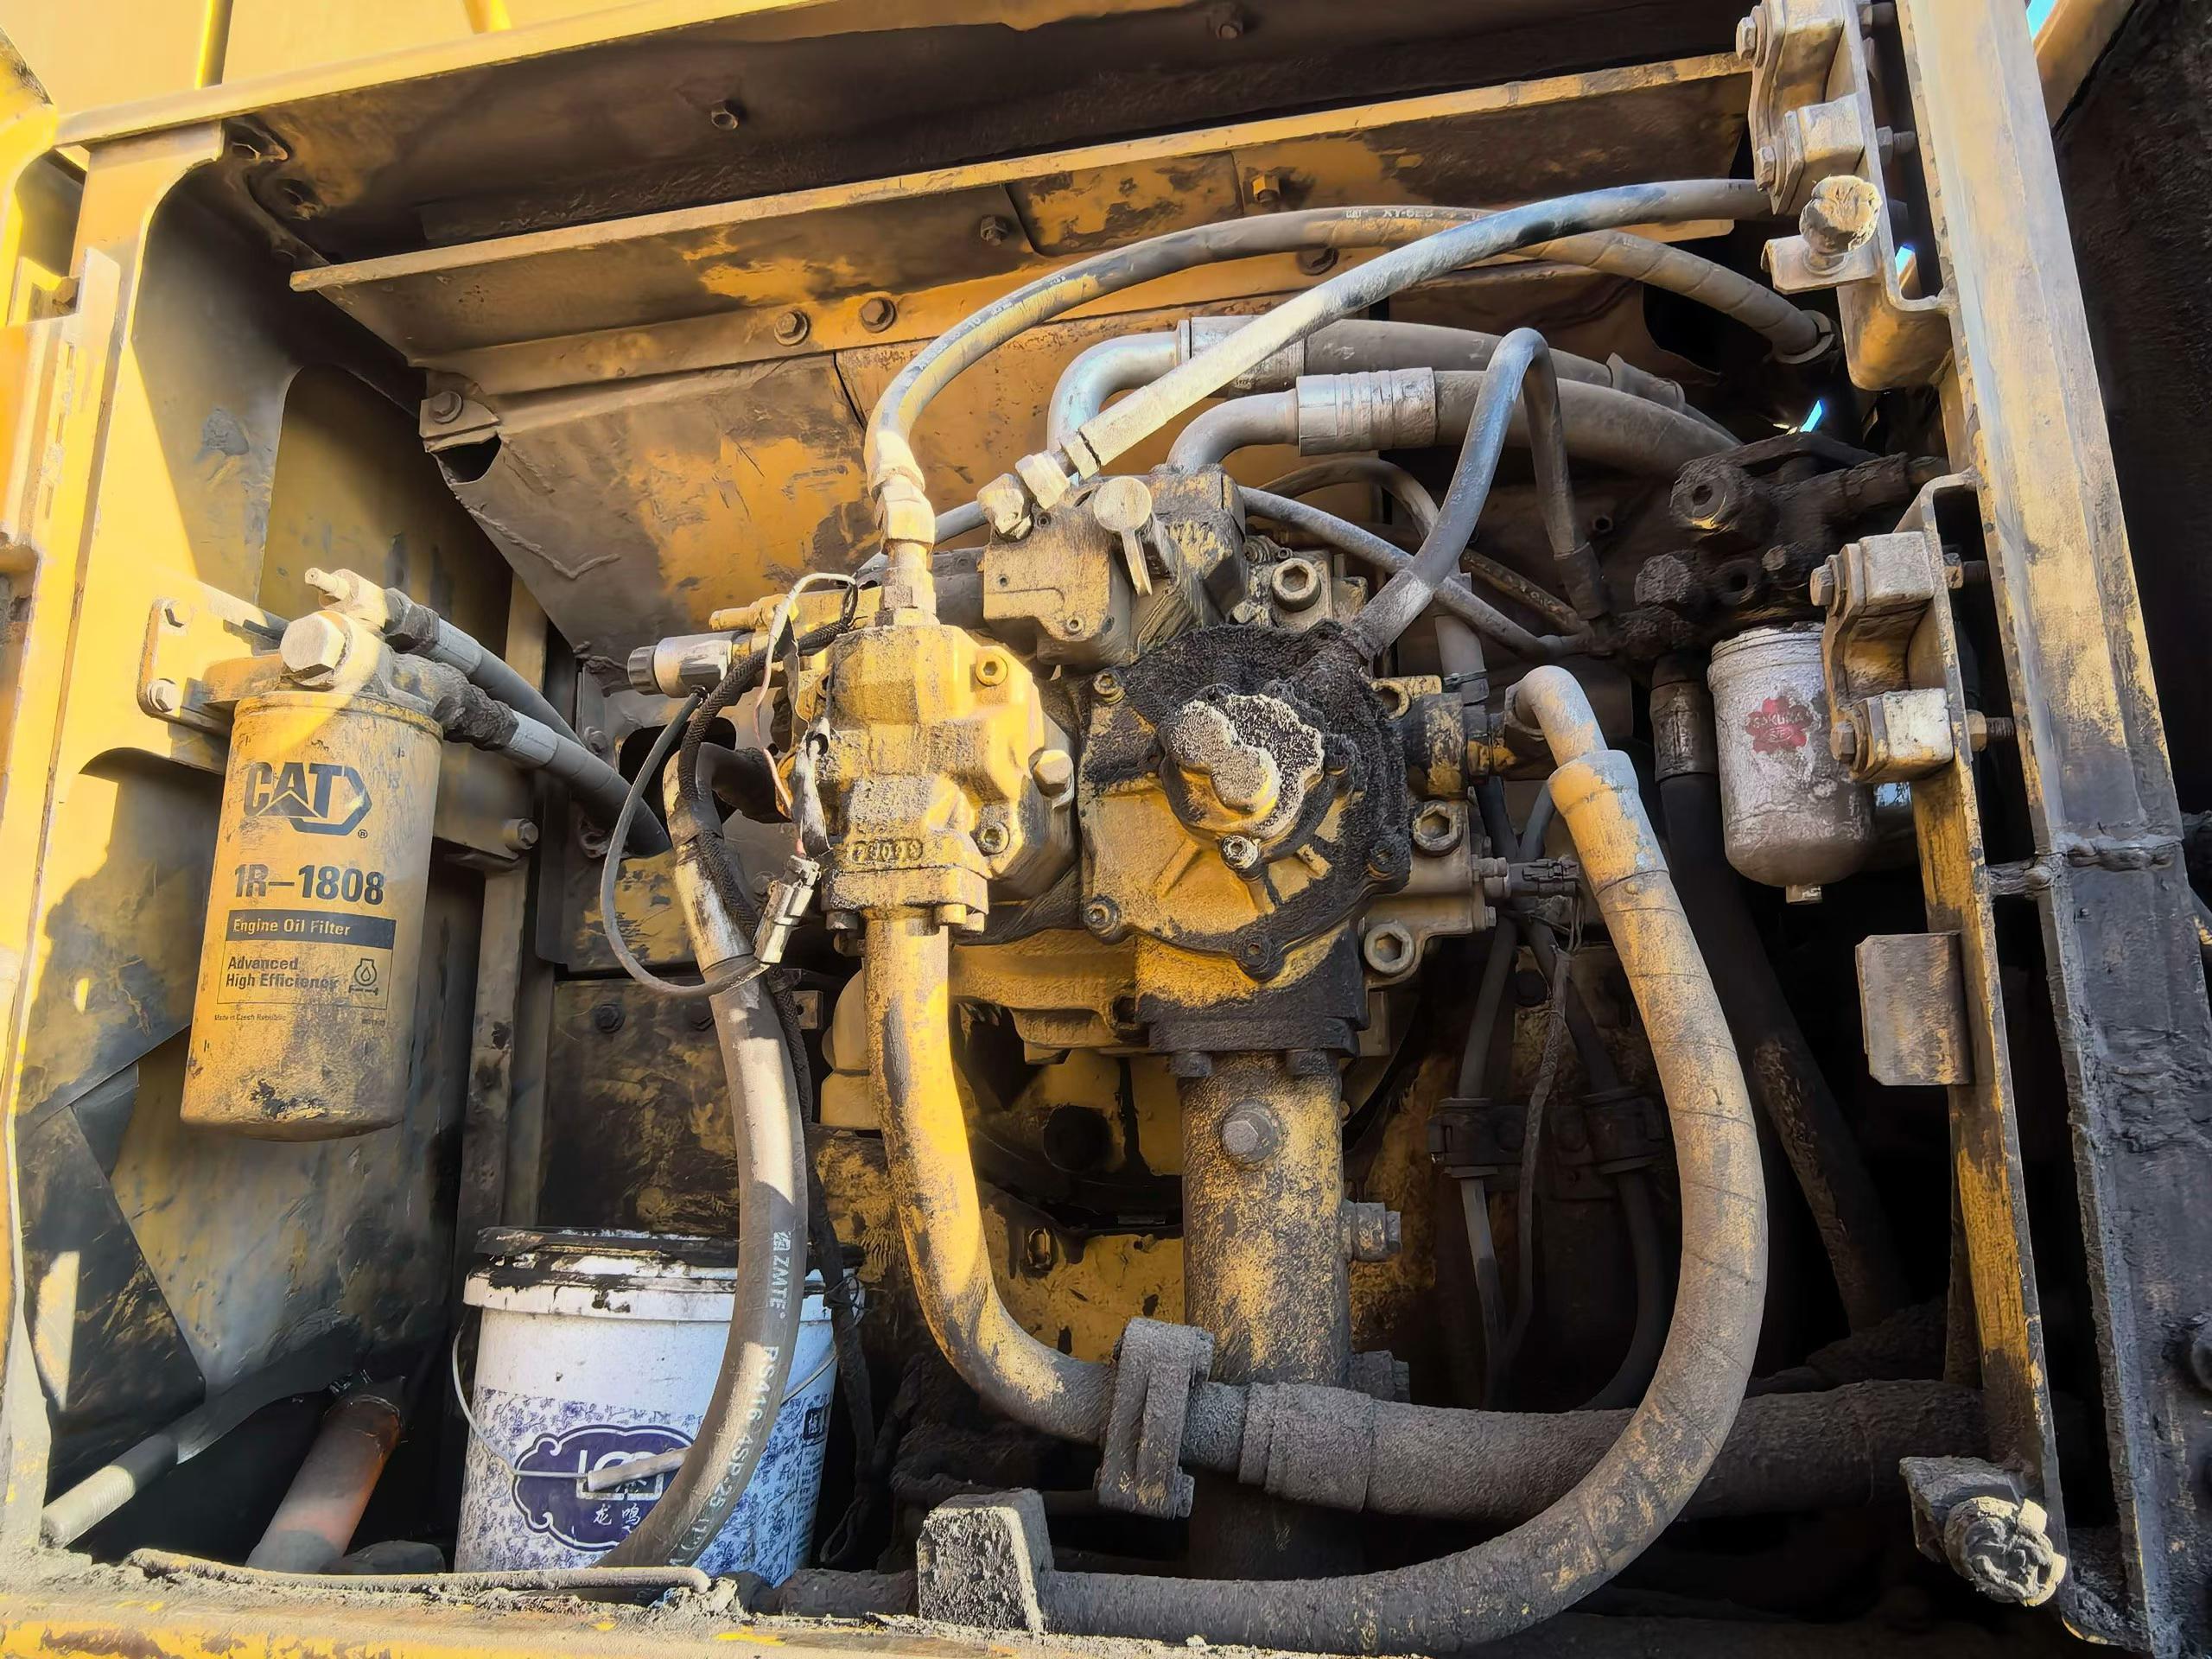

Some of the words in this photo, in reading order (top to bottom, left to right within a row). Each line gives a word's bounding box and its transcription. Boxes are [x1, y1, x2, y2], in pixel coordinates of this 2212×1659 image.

[244, 762, 343, 818] CAT
[234, 864, 385, 906] 1R-1808
[232, 918, 278, 934] Engine
[283, 919, 305, 932] Oil
[310, 920, 351, 936] Filter
[228, 956, 299, 970] Advanced
[226, 973, 256, 990] High
[259, 973, 338, 991] Efficiency
[593, 1502, 641, 1526] 龙鸣
